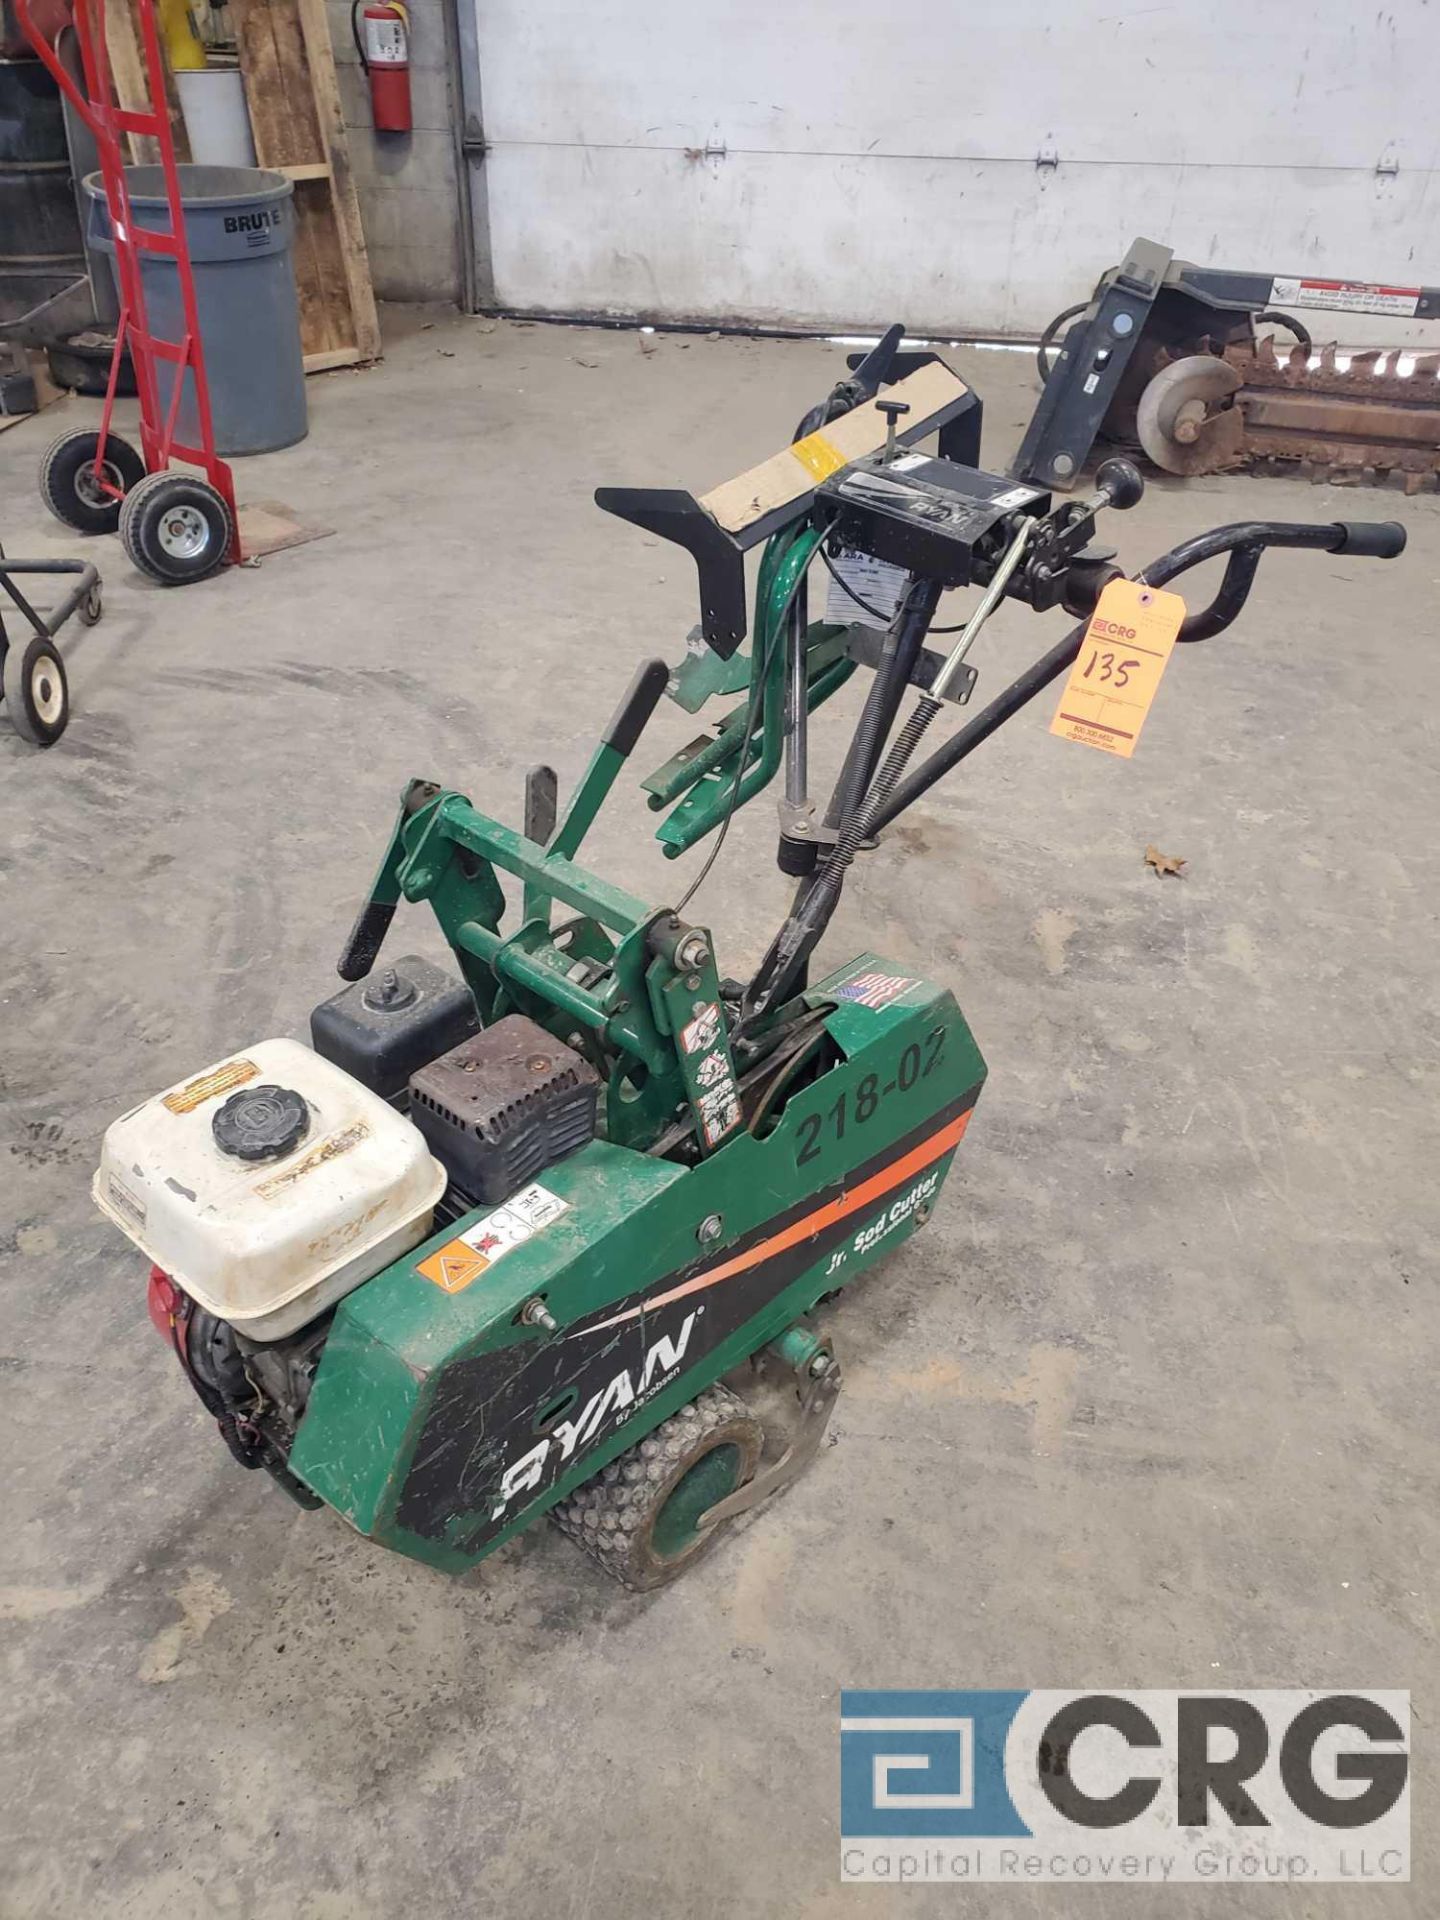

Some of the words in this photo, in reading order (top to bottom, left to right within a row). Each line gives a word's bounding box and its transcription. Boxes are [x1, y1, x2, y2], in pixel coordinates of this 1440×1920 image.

[224, 210, 281, 233] BRUTE
[909, 502, 970, 525] RYAN
[1108, 623, 1137, 640] CRG
[1083, 651, 1140, 688] 135
[795, 1024, 947, 1169] 218-02
[825, 1251, 847, 1275] Jr.
[853, 1213, 887, 1252] Sod
[889, 1170, 939, 1221] Cutter
[491, 1311, 697, 1522] RYAN
